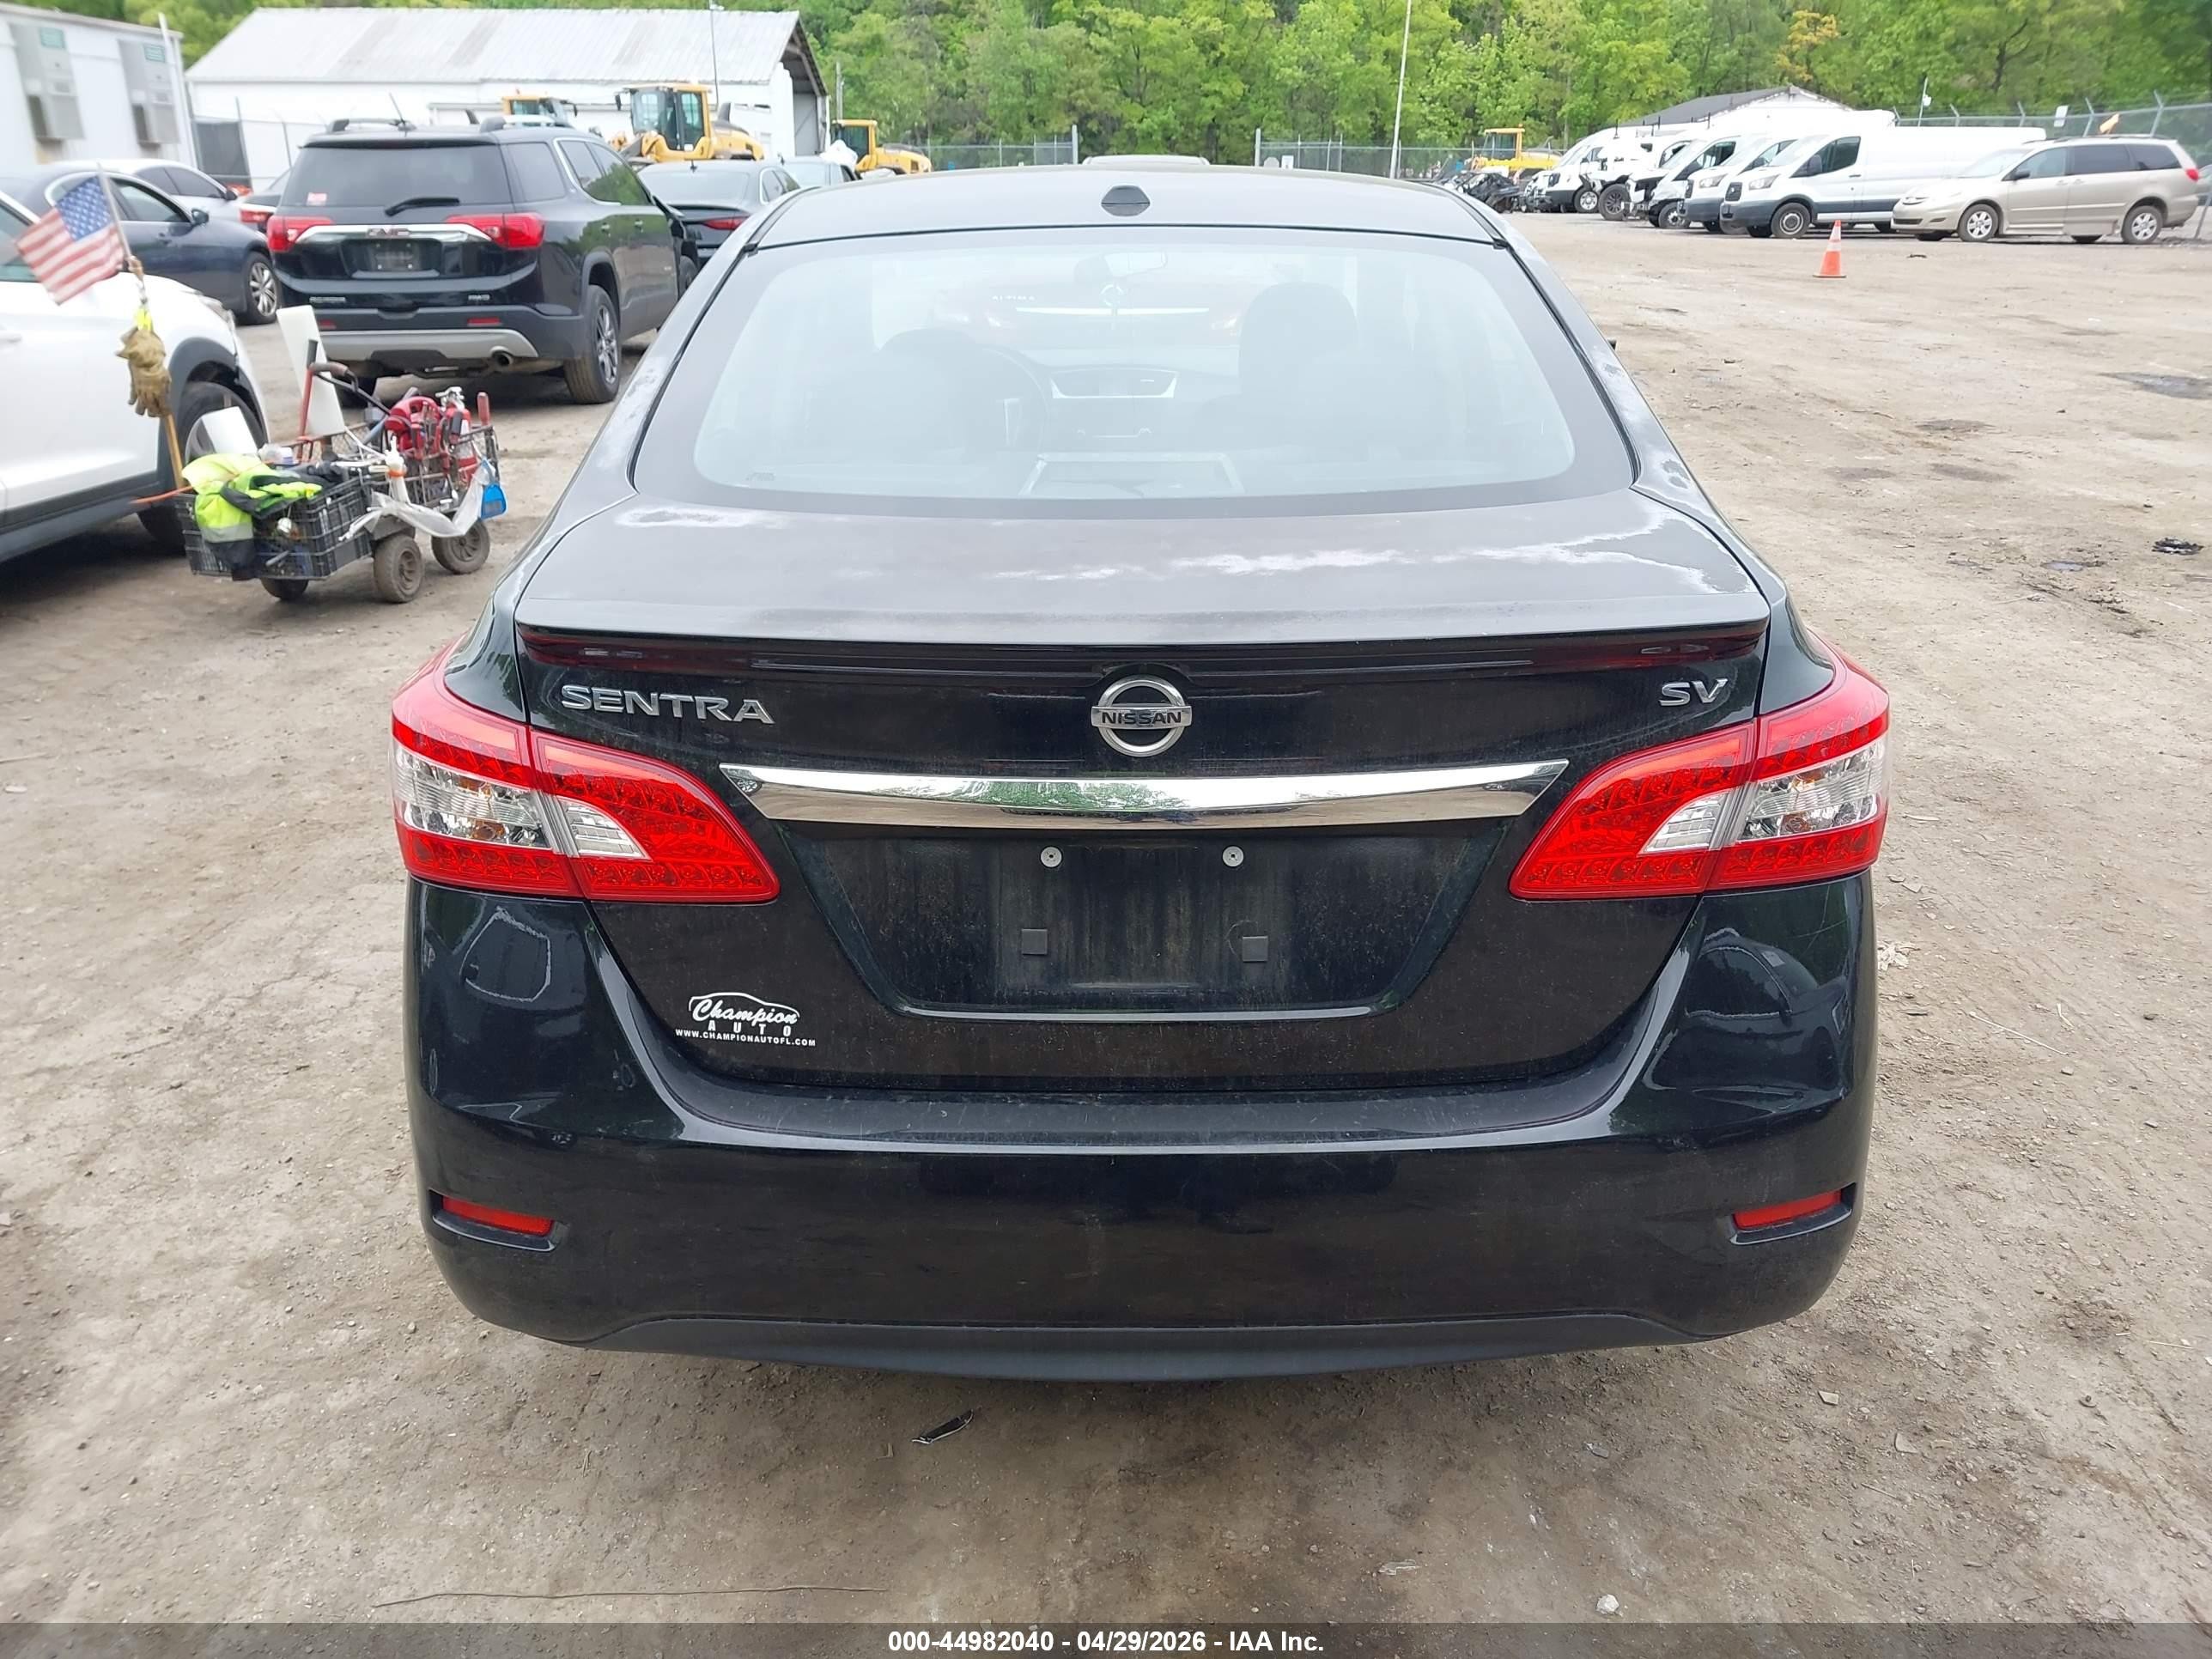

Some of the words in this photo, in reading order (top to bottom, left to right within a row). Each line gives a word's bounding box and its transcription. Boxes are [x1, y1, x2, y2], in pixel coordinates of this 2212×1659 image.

[561, 684, 775, 725] SENTRA
[1658, 678, 1729, 707] SV
[1102, 711, 1182, 725] NISSAN
[692, 999, 798, 1027] Champion
[675, 1029, 816, 1047] WWW.CHAMPIONAUTOFL.COM
